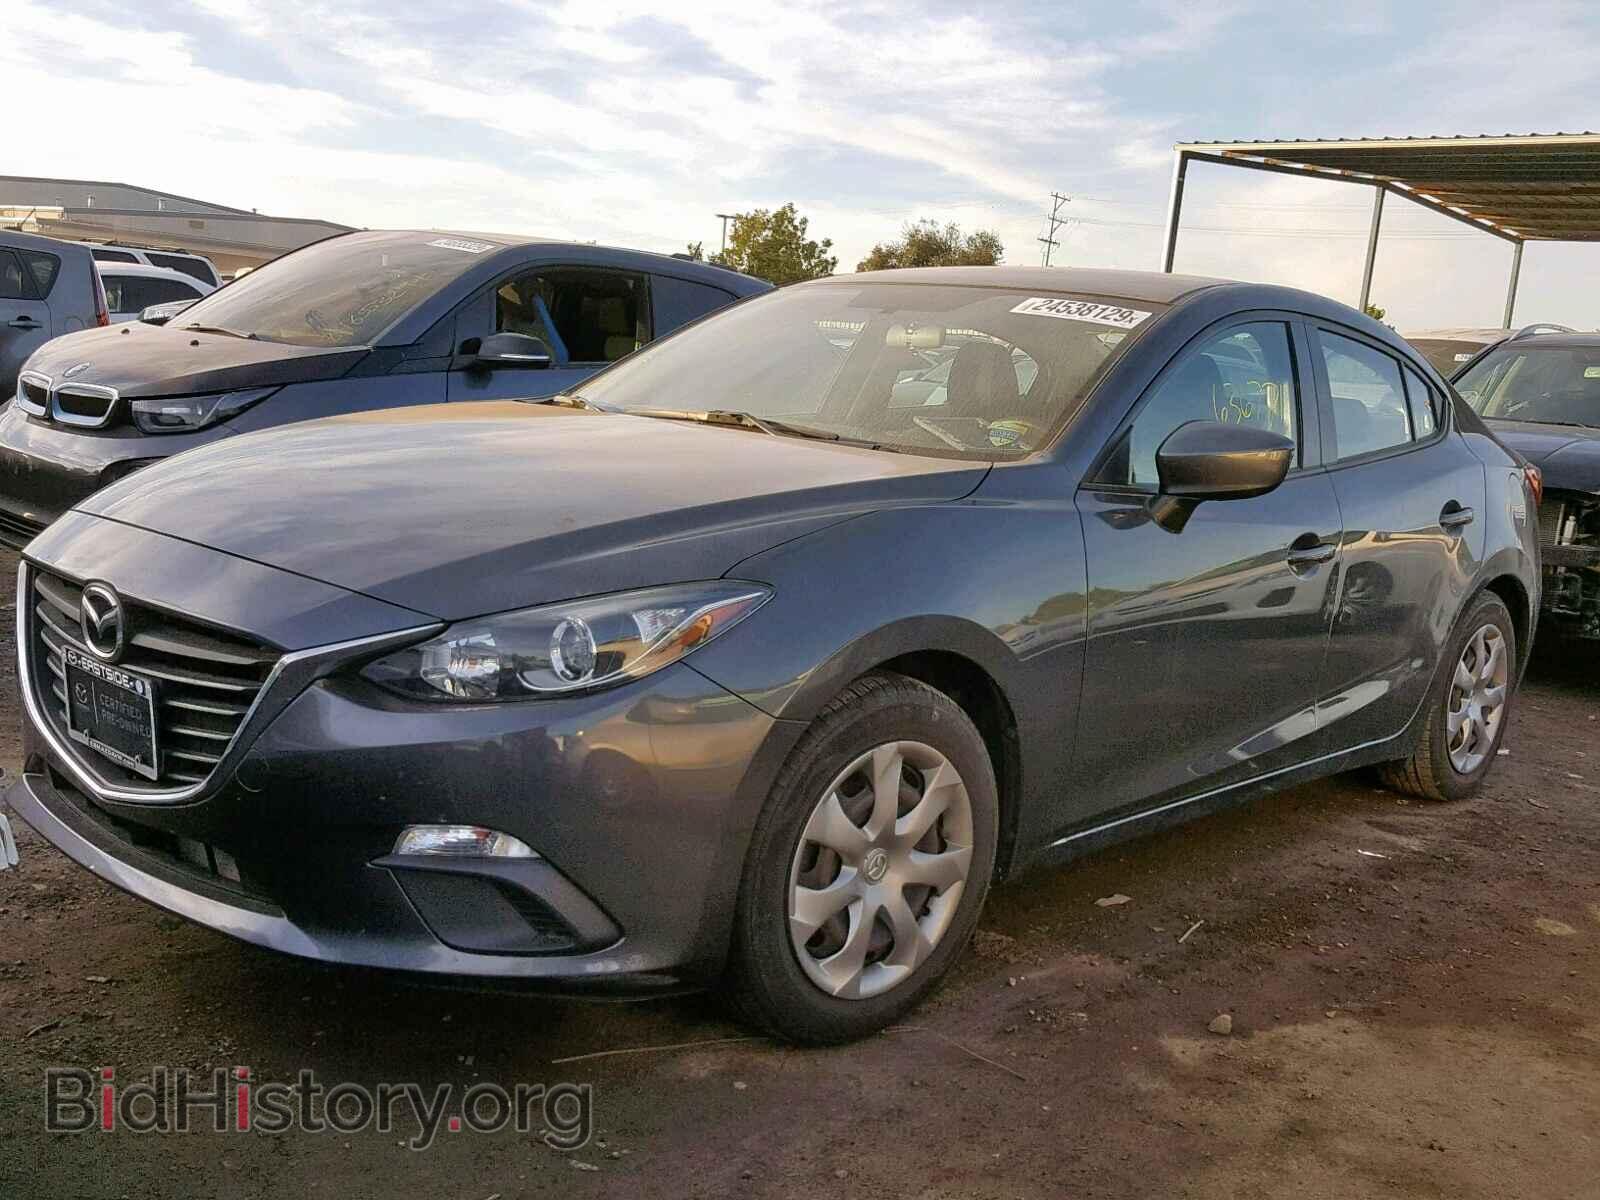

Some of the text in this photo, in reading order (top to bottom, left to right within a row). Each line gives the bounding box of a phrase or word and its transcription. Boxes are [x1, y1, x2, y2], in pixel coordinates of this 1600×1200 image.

[81, 657, 130, 688] EASTSIDE
[99, 694, 143, 720] CERTIFIED
[101, 710, 152, 738] PRE-OWNED
